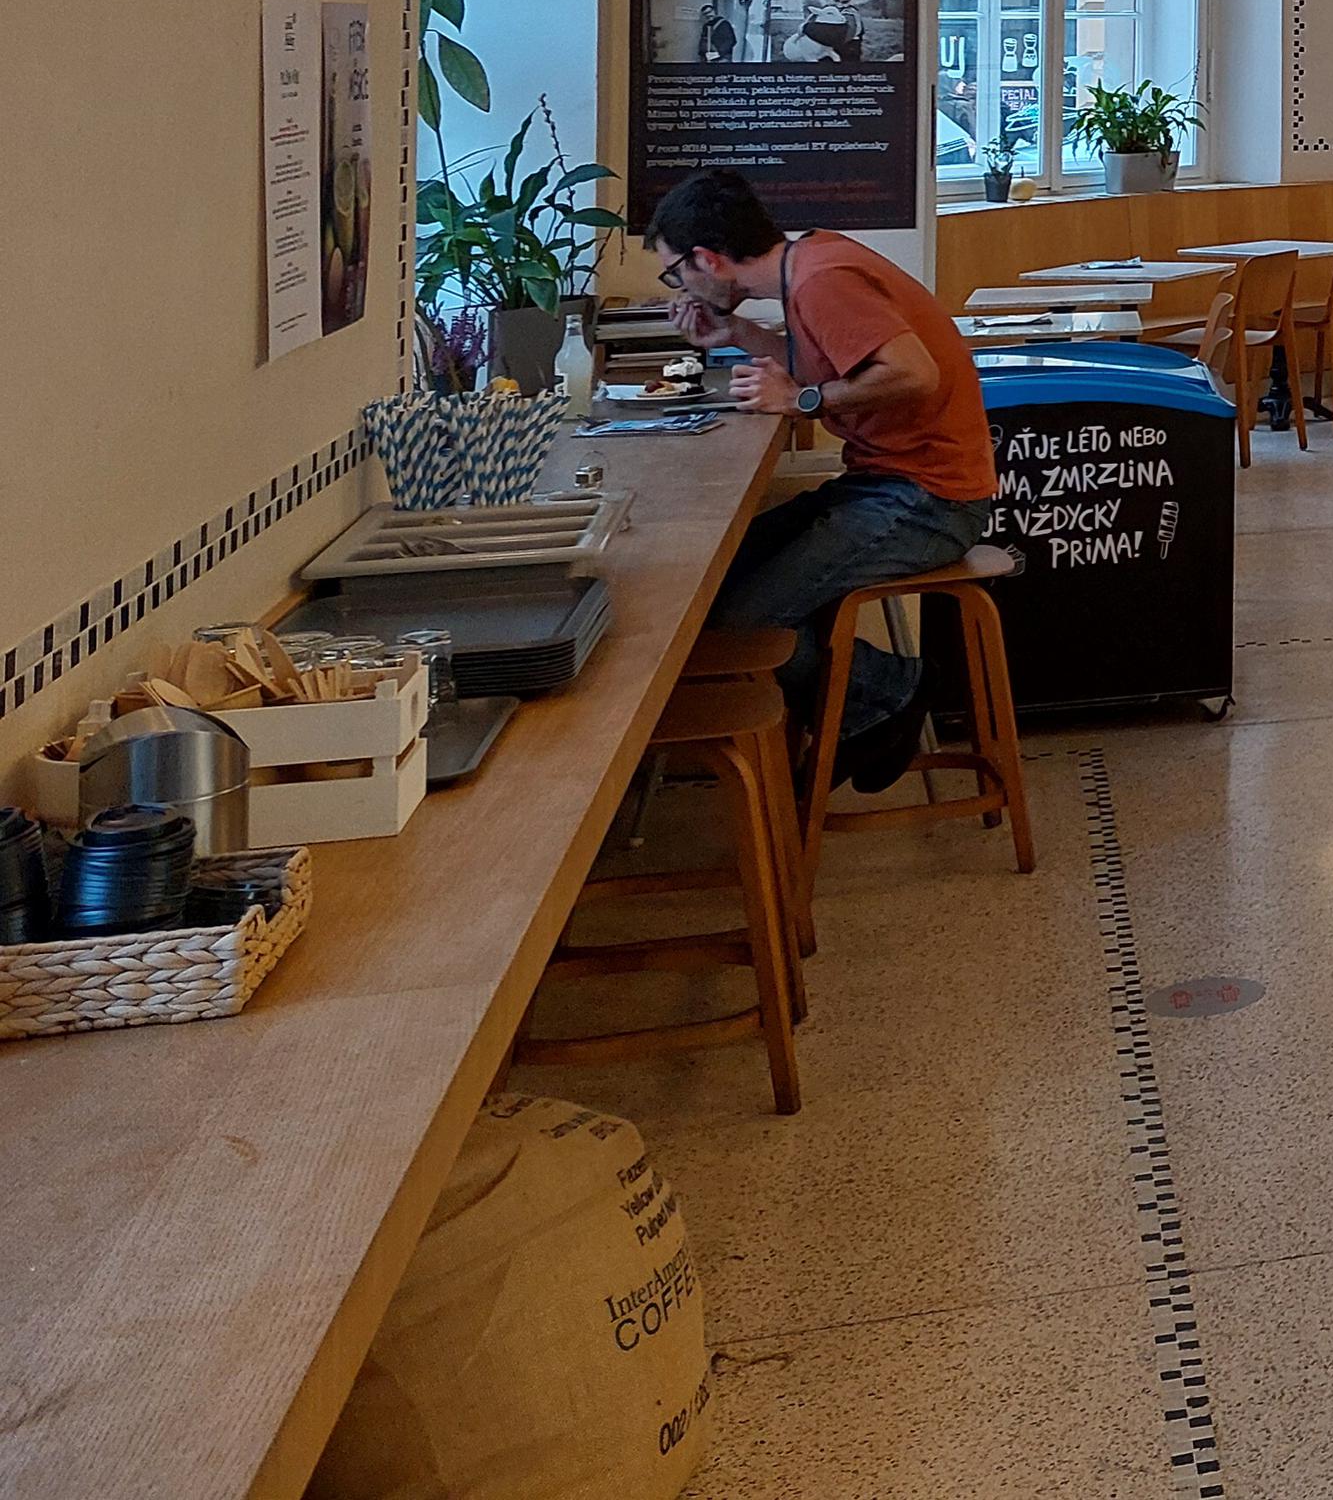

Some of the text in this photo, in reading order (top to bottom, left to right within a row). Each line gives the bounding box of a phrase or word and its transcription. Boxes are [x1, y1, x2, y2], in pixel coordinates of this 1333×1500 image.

[1007, 426, 1167, 461] AŤ JE LÉTO NEBO
[1041, 459, 1174, 497] ZMRZLINA
[981, 498, 1121, 537] JE VŽDYCKY
[1049, 531, 1143, 568] PRIMA!
